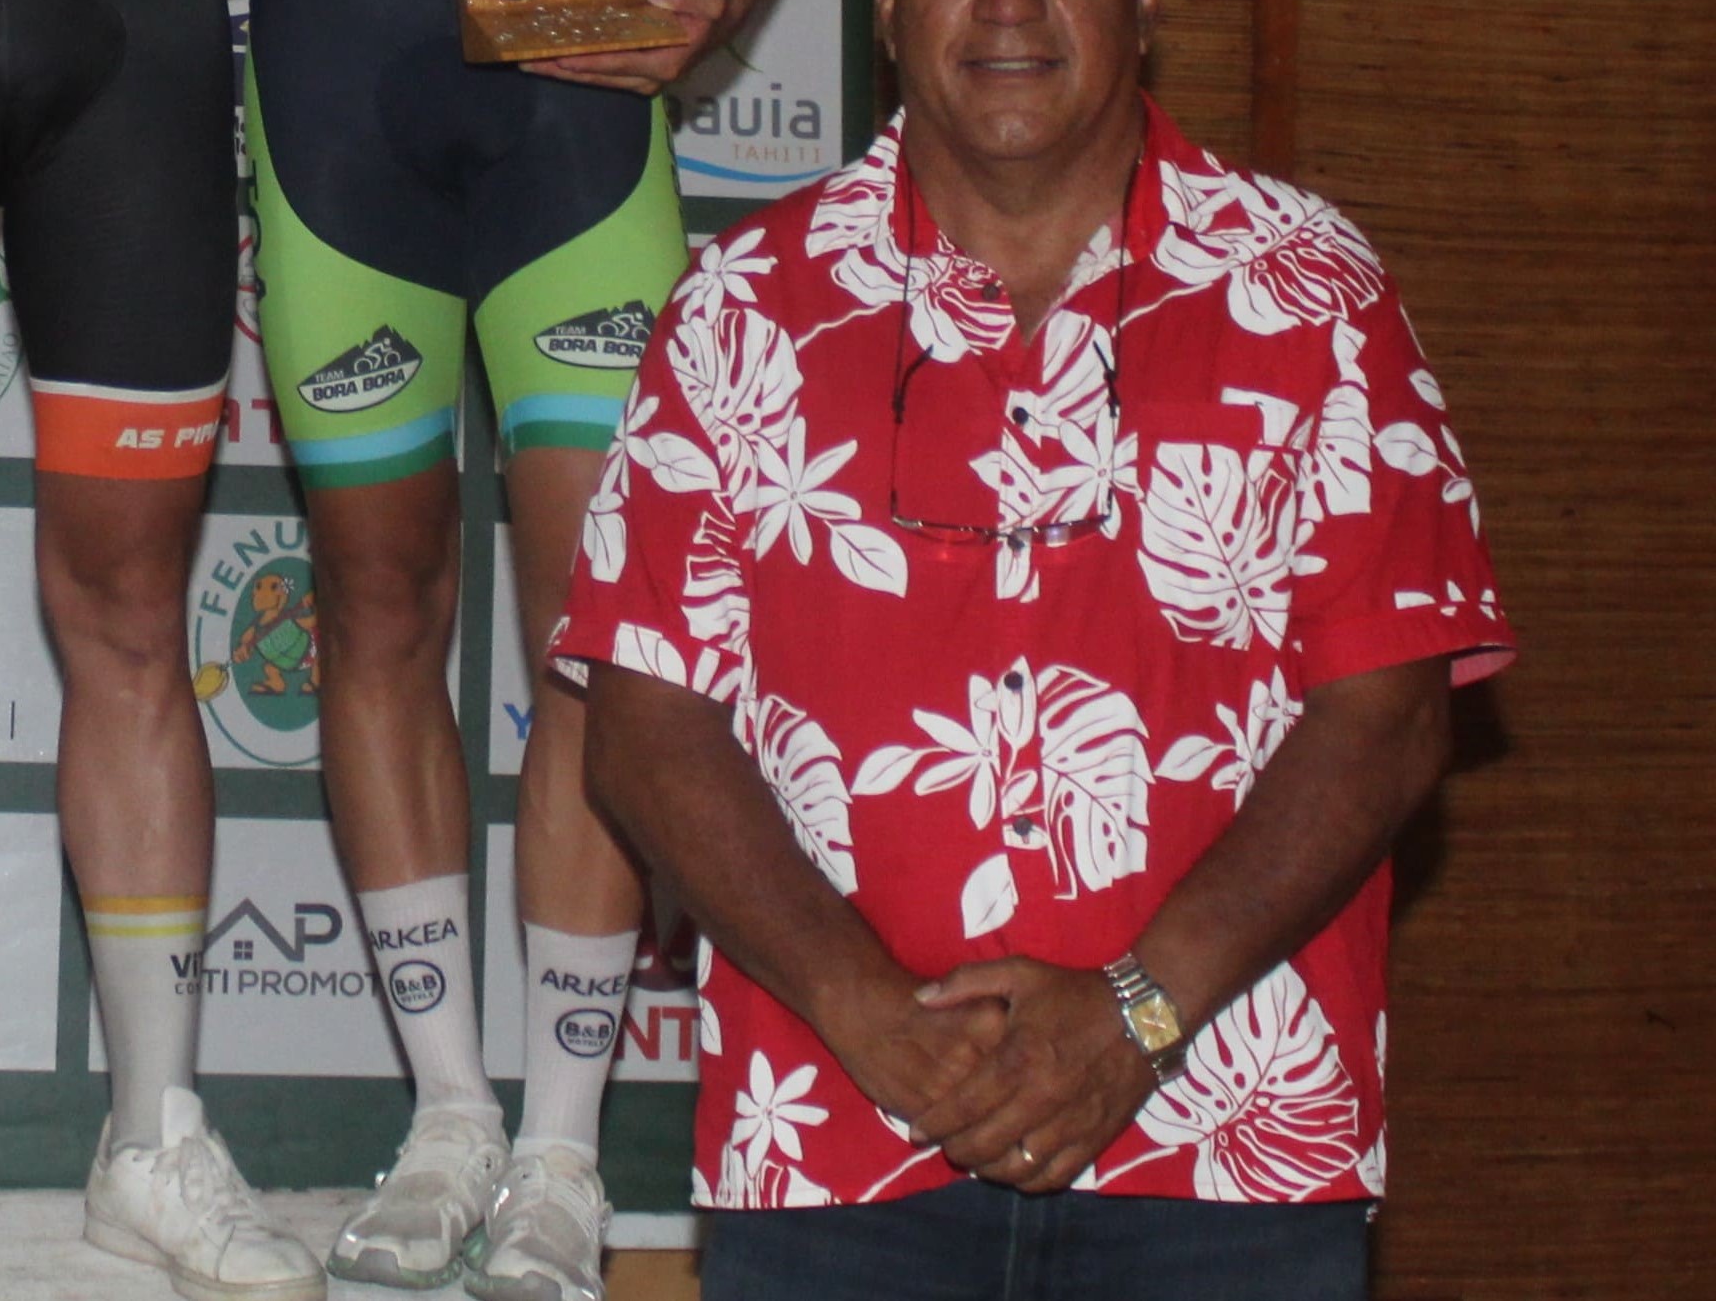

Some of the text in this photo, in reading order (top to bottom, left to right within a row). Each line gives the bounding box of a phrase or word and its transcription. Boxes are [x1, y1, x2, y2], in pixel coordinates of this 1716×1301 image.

[732, 145, 821, 165] TAHITI
[555, 325, 587, 337] TEAM
[548, 338, 598, 354] BORA
[312, 367, 406, 402] BORA BORA
[315, 370, 345, 383] TEAM
[115, 428, 165, 450] AS
[394, 974, 438, 996] B&B
[565, 1021, 611, 1039] B&B
